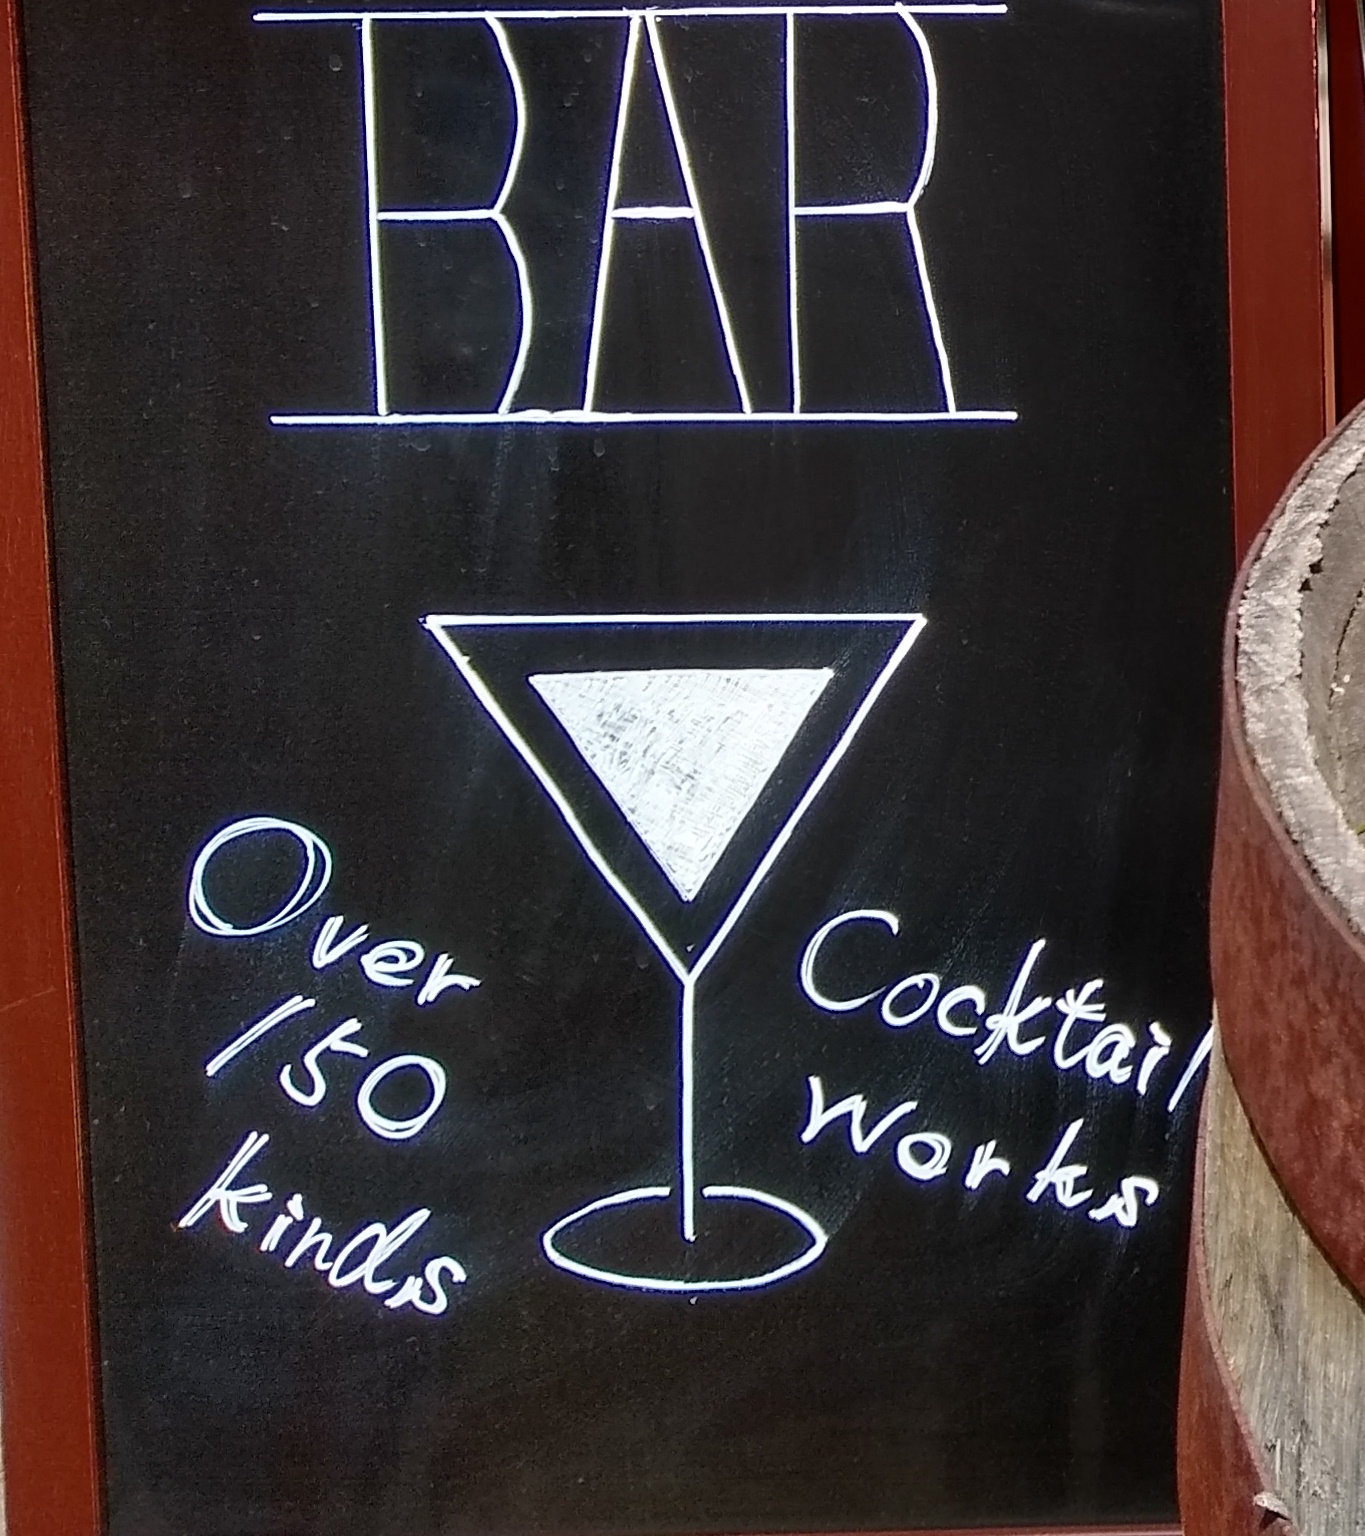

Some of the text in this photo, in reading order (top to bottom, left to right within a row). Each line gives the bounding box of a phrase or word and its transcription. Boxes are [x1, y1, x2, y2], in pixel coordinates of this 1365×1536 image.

[361, 0, 958, 418] BAR
[189, 816, 482, 1005] Over
[206, 995, 446, 1141] 150
[799, 909, 1214, 1114] Cocktail
